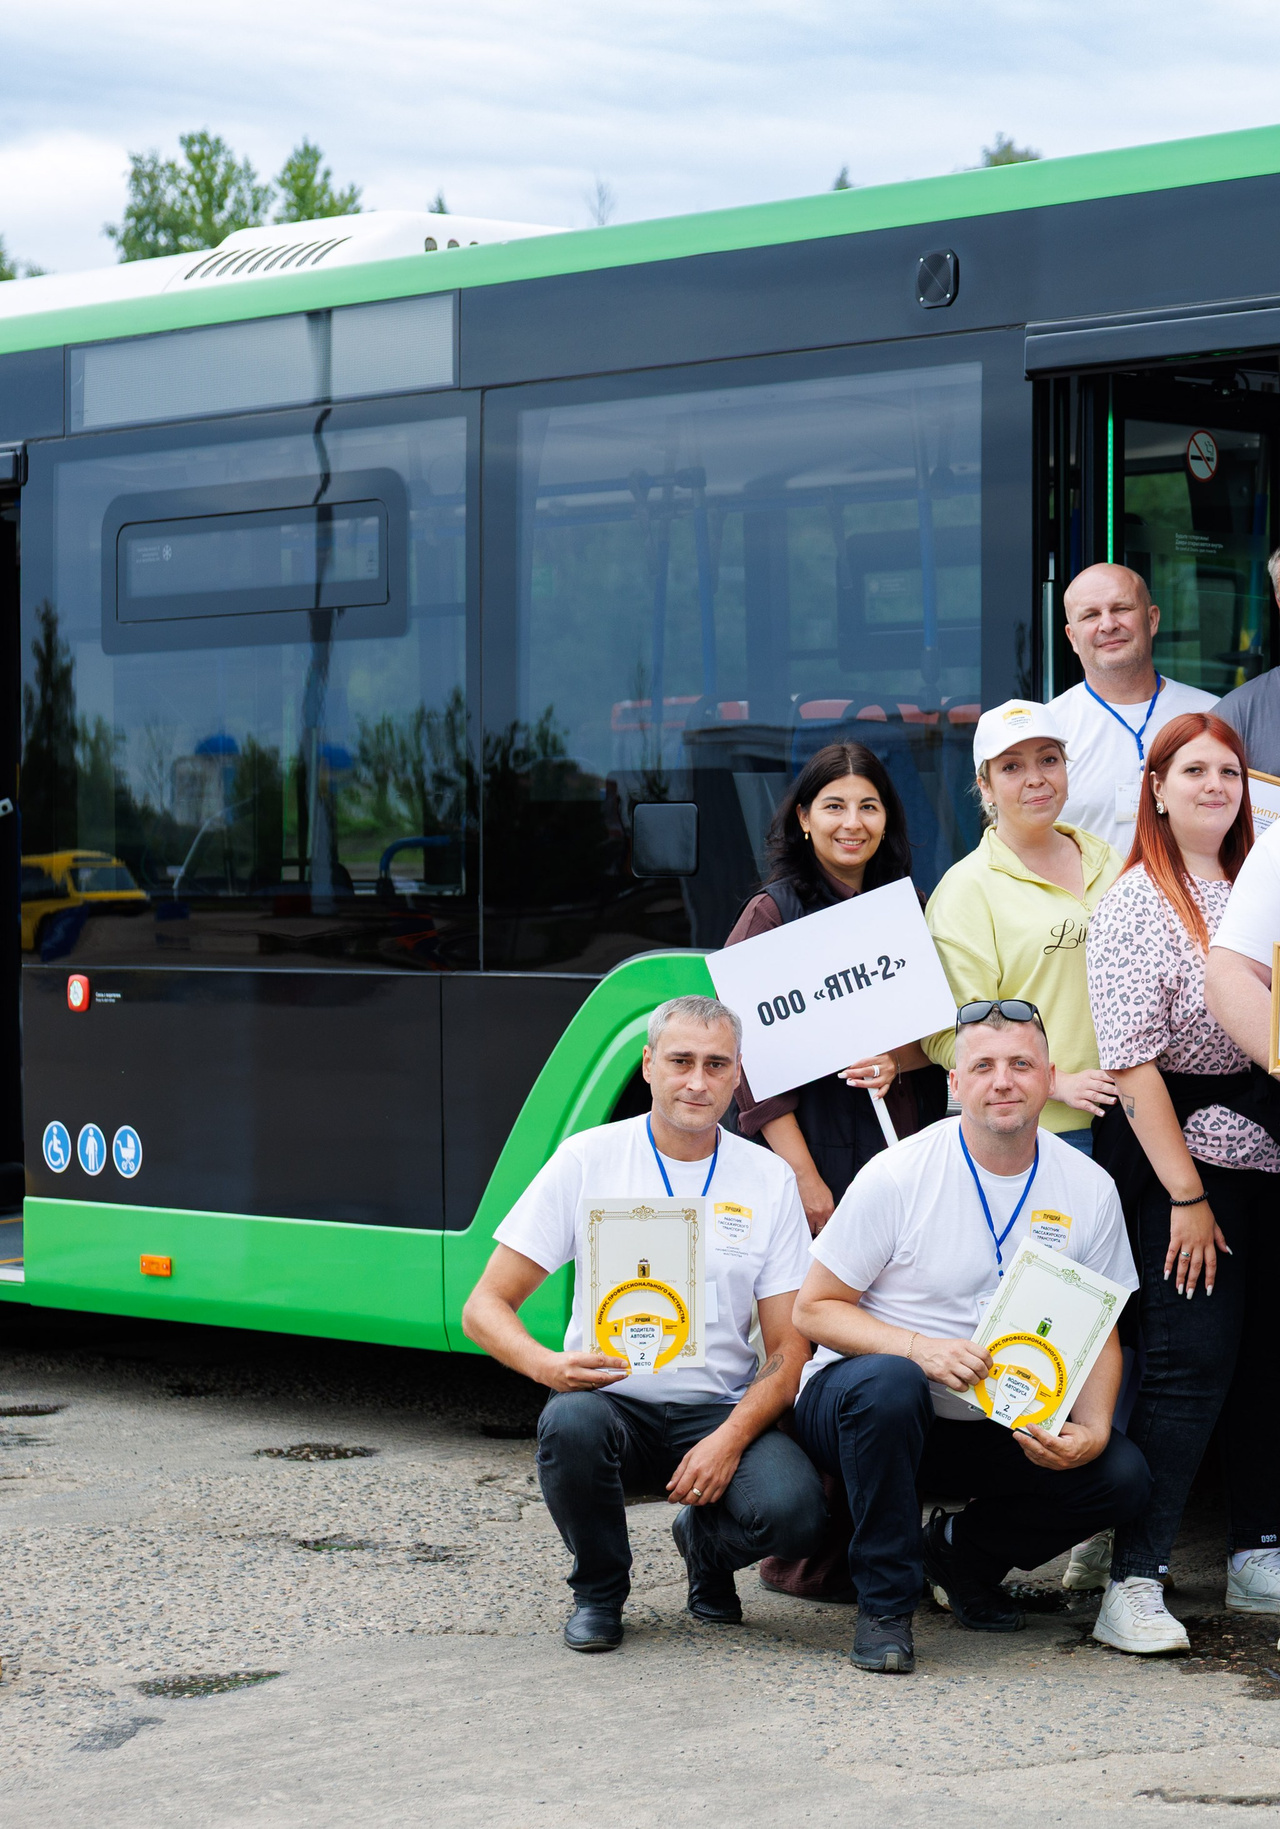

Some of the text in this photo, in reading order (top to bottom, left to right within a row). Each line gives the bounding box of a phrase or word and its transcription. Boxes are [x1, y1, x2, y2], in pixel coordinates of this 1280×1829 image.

[757, 955, 906, 1026] ООО «ЯТК-2»
[1033, 1229, 1066, 1239] ПАССАЖИРСКОГО
[1037, 1235, 1061, 1243] ТРАНСПОРТА
[598, 1282, 685, 1325] КОНКУРС ПРОФЕССИОНАЛЬНОГО МАСТЕРСТВА
[989, 1336, 1064, 1397] КУРС ПРОФЕССИОНАЛЬНОГО МАСТЕРСТВА
[1005, 1384, 1027, 1397] АВТОБУСА
[1007, 1377, 1030, 1391] ВОДИТЕЛЬ
[995, 1410, 1011, 1420] МЕСТО
